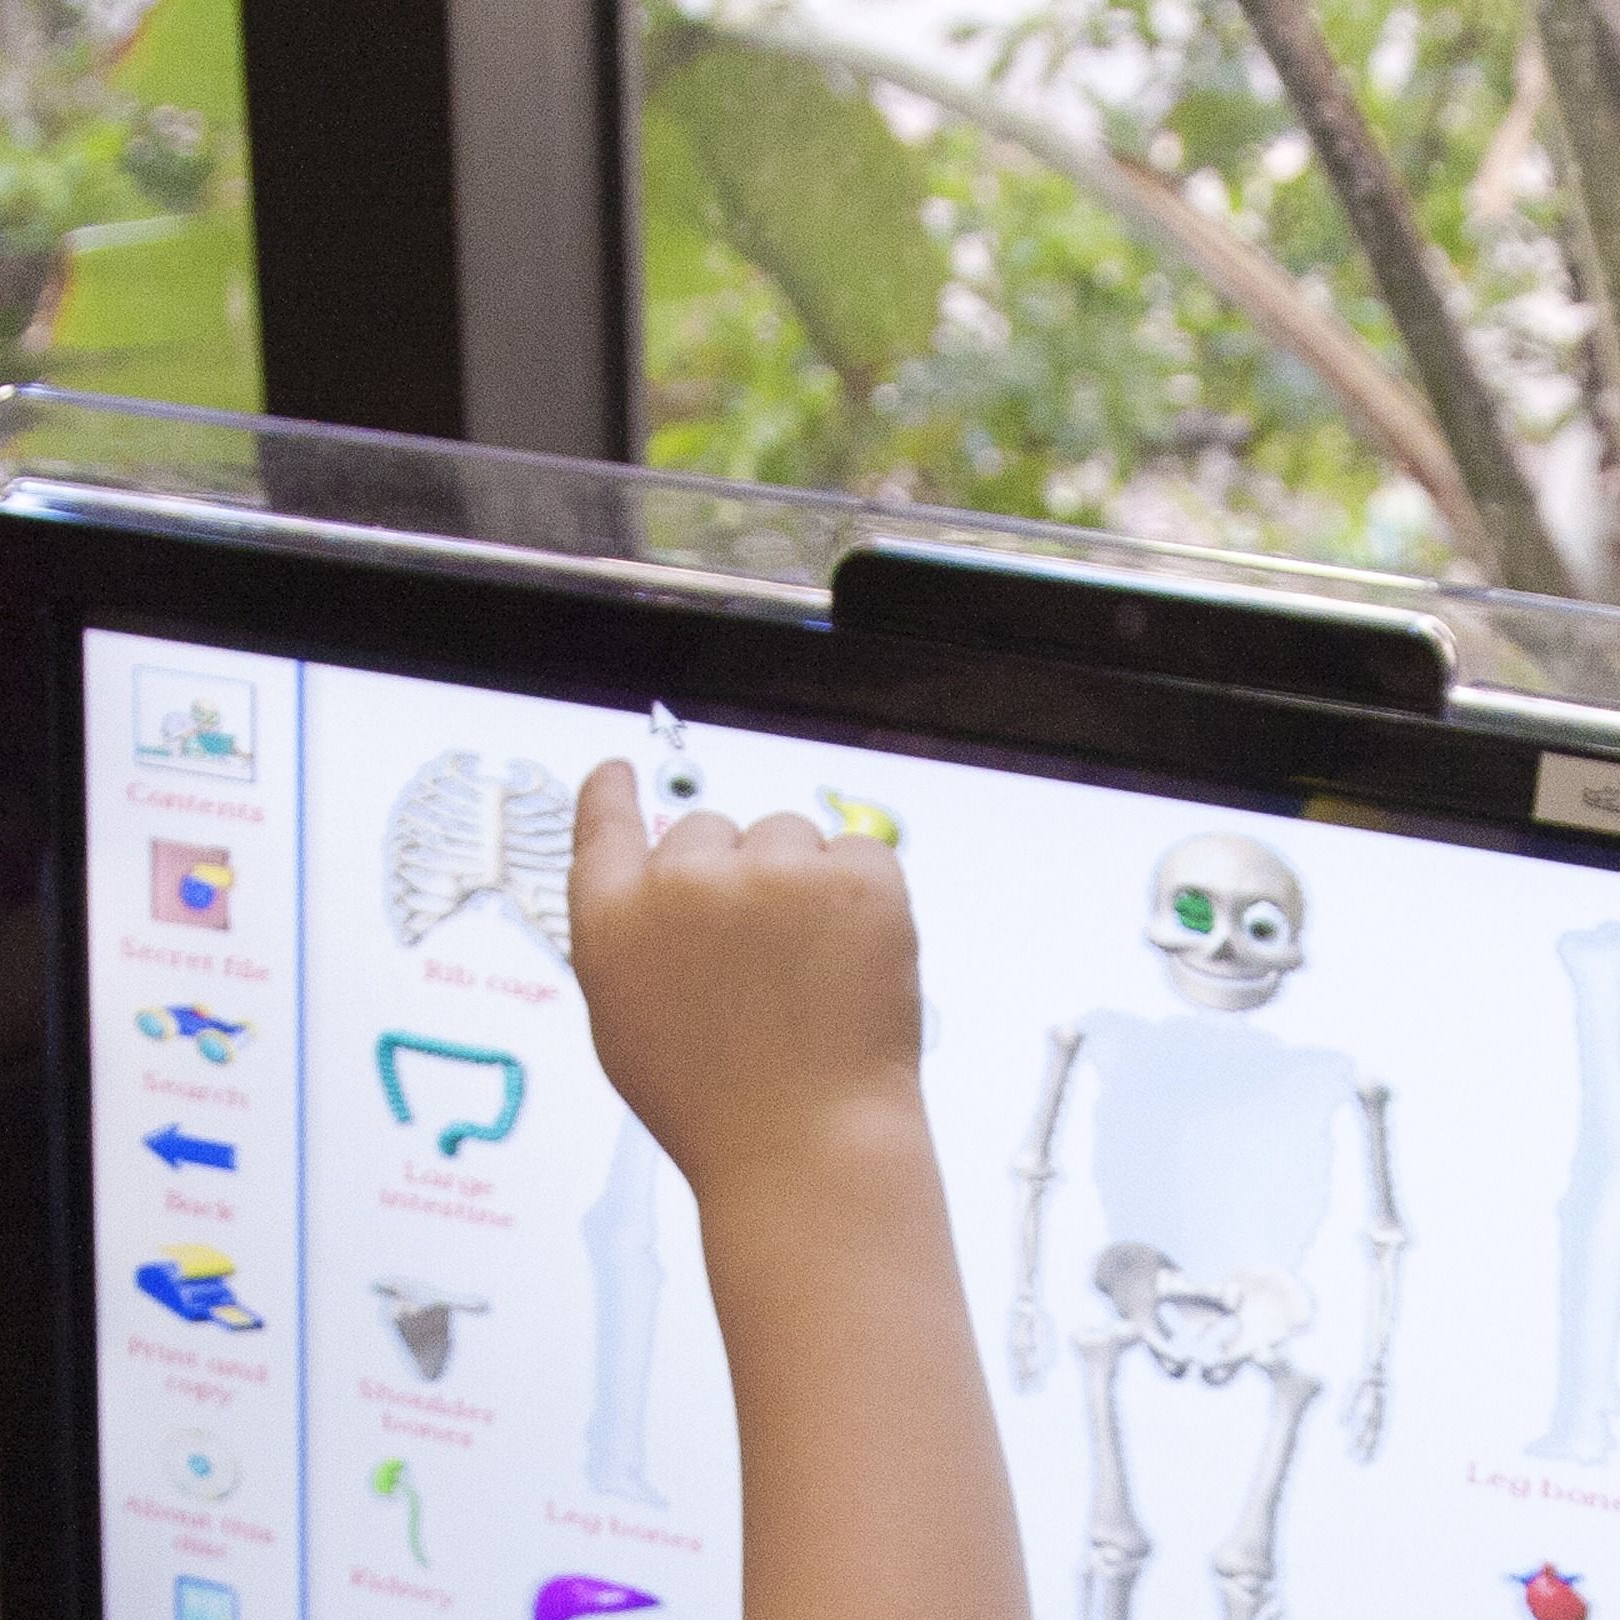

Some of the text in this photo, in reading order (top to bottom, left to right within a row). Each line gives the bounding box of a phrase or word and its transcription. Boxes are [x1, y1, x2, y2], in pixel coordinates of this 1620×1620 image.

[126, 781, 266, 825] Contents
[120, 936, 272, 984] Secret file
[423, 958, 561, 1005] Rib cage
[140, 1069, 251, 1110] Search
[404, 1161, 493, 1198] Large
[1466, 1461, 1532, 1500] Leg
[544, 1499, 704, 1553] Leg bones
